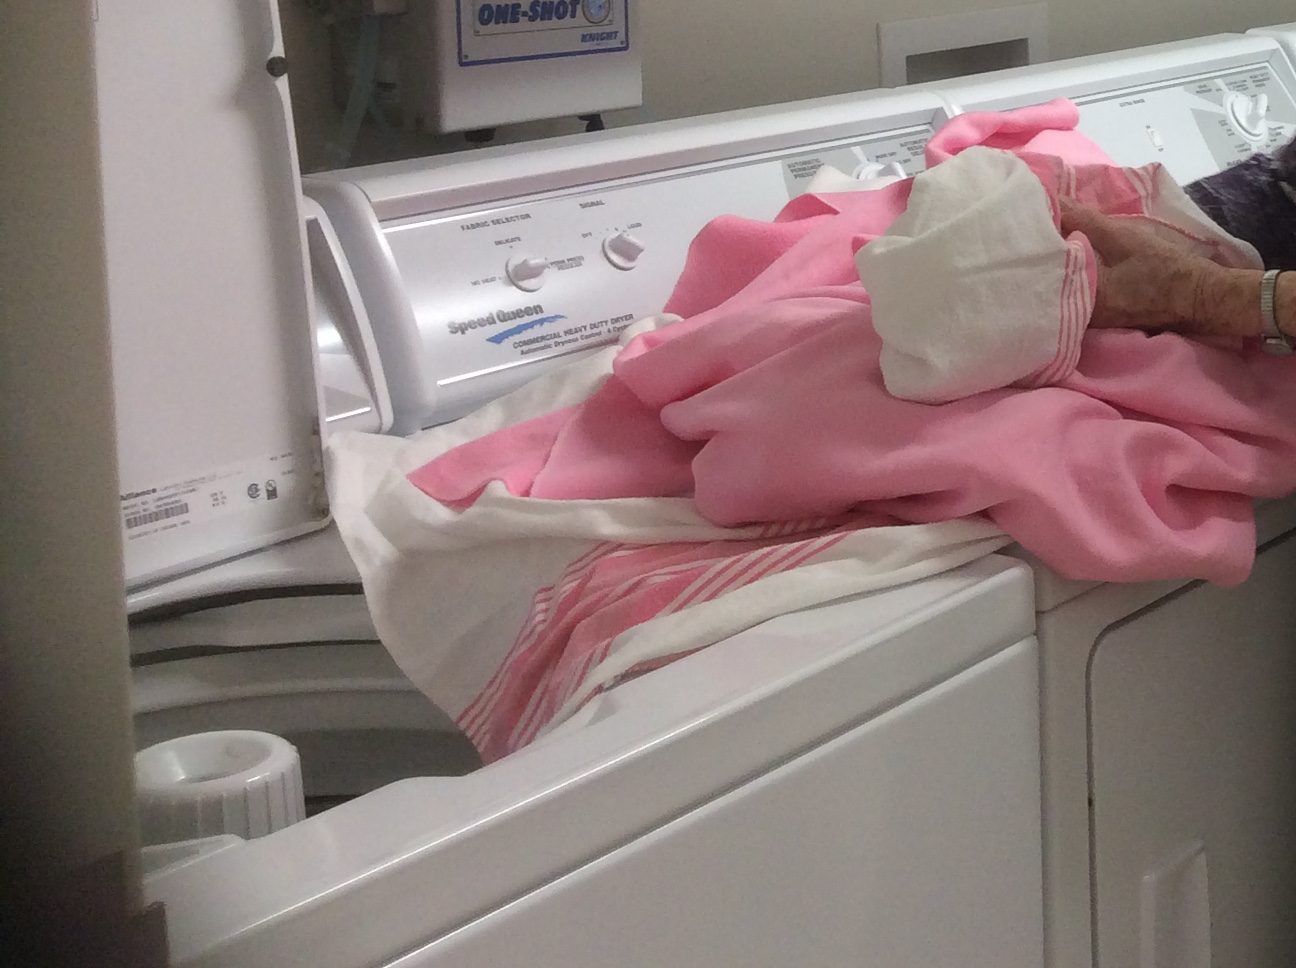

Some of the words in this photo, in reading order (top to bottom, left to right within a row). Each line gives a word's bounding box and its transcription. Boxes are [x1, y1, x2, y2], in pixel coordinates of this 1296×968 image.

[580, 30, 620, 44] KNIGHT
[460, 219, 490, 231] FABRIC
[490, 212, 532, 227] SELECTOR
[447, 310, 497, 336] Speed
[496, 302, 544, 323] Queen
[512, 331, 562, 349] COMMERCIAL
[563, 324, 588, 338] HEAVY
[589, 319, 609, 331] DUTY
[610, 313, 634, 325] DRYER
[520, 343, 553, 356] Automatic
